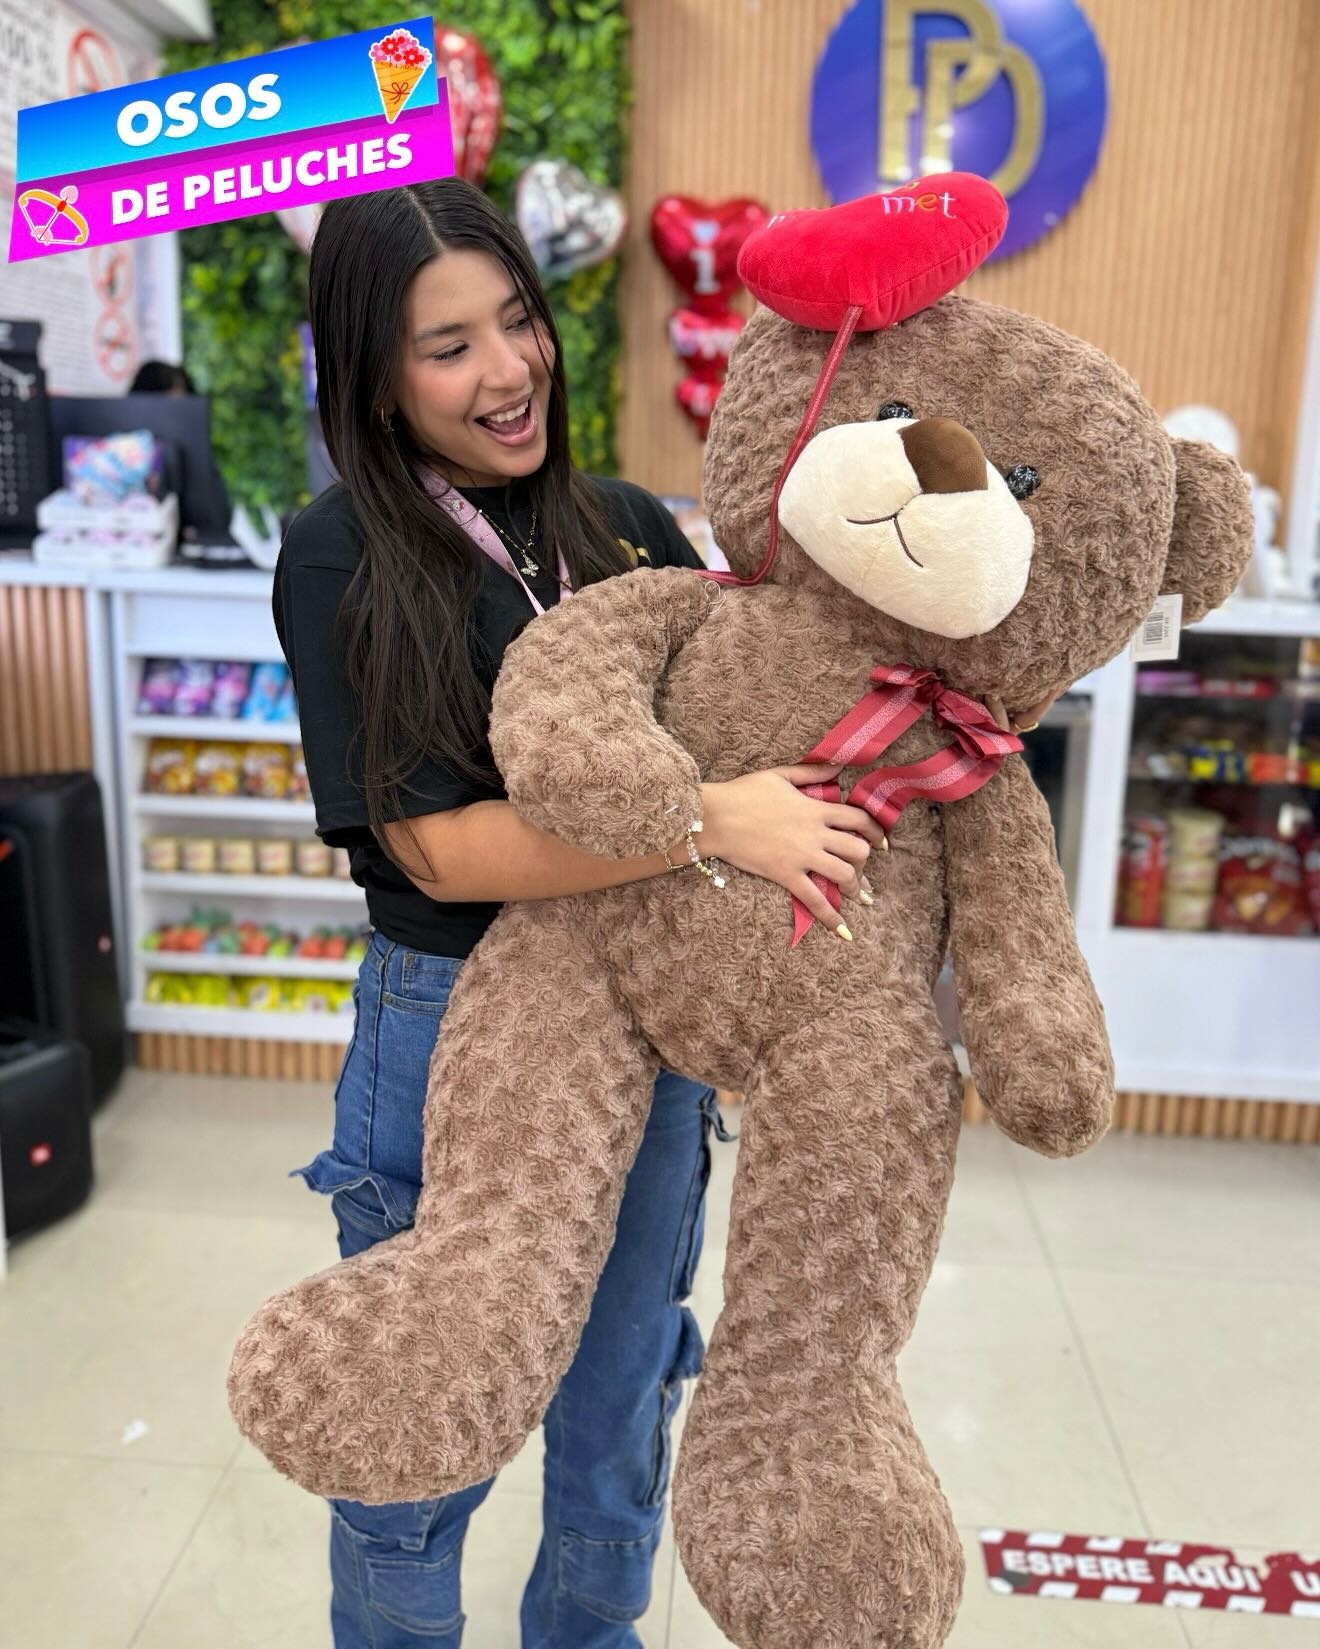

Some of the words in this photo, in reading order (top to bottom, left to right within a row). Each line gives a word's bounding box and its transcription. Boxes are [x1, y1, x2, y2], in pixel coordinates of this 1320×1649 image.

[881, 192, 957, 219] met
[1001, 1549, 1154, 1584] ESPERE
[1162, 1561, 1262, 1592] AQUI
